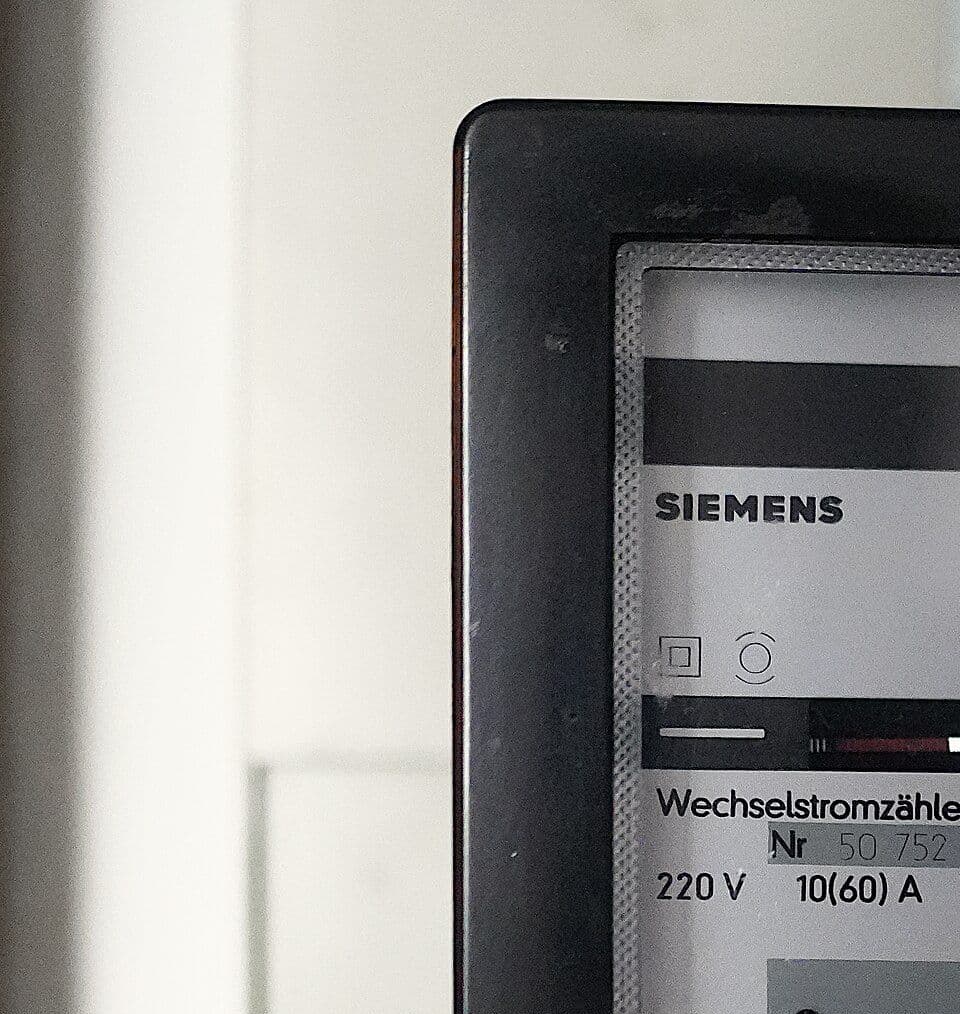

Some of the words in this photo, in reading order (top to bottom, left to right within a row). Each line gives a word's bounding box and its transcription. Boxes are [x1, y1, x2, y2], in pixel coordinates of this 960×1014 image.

[655, 492, 844, 524] SIEMENS
[771, 829, 807, 860] Nr
[840, 832, 877, 861] 50
[896, 833, 947, 862] 752
[656, 872, 714, 901] 220
[723, 872, 746, 901] V
[796, 871, 888, 906] 10(60)
[898, 874, 923, 903] A
